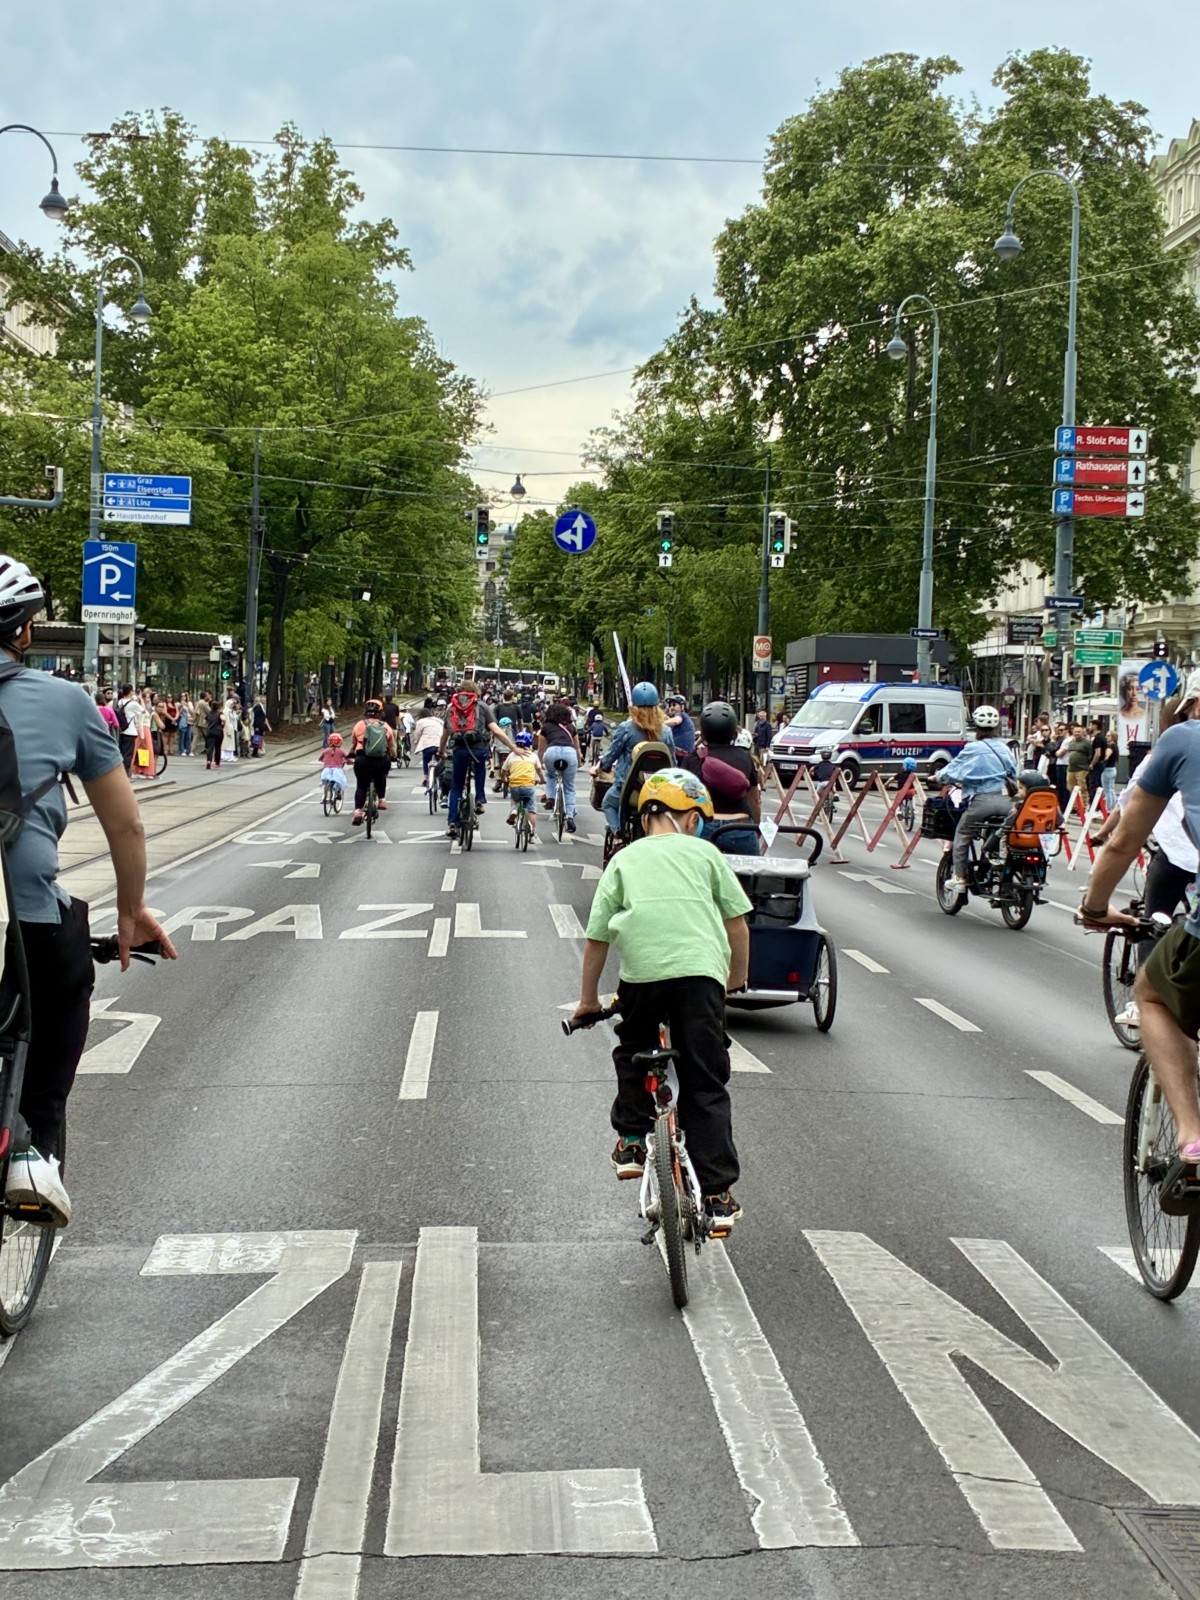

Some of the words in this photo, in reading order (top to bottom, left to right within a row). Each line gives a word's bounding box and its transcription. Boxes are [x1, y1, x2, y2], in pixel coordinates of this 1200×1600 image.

[1076, 436, 1085, 445] R.
[1086, 436, 1107, 445] Stolz
[1108, 437, 1128, 446] Platz
[1075, 461, 1127, 472] Rathauspark
[136, 477, 153, 485] Graz
[136, 486, 173, 494] Eisenstadt
[136, 499, 151, 507] Linz
[116, 512, 167, 521] Hauptbahnhof
[101, 544, 119, 552] 150m
[100, 564, 121, 595] P
[83, 609, 133, 621] Opernringhof
[892, 747, 919, 756] POLIZEI
